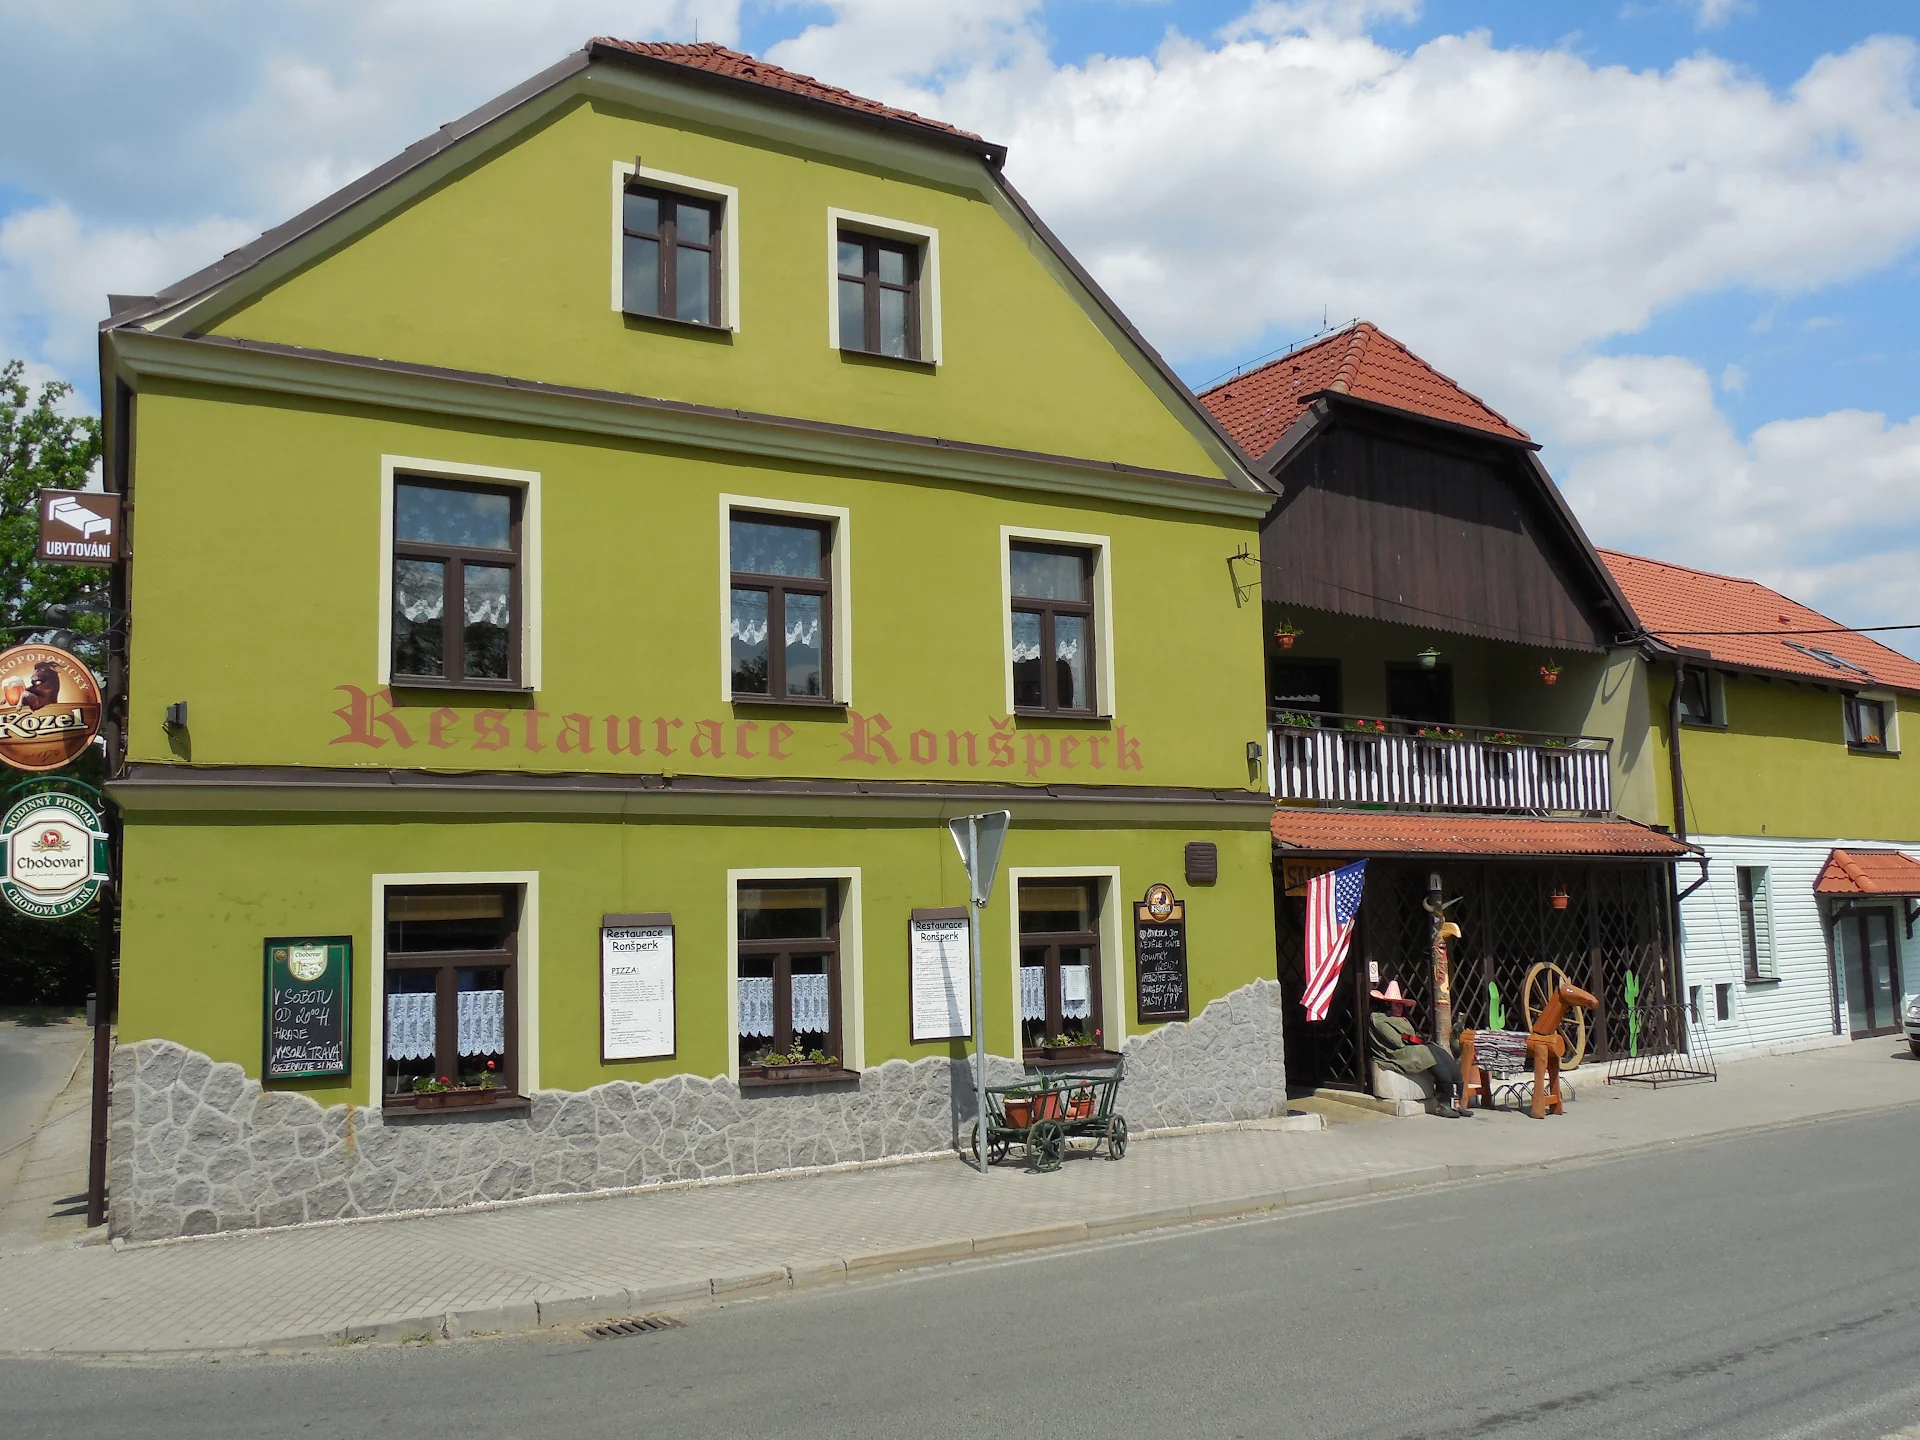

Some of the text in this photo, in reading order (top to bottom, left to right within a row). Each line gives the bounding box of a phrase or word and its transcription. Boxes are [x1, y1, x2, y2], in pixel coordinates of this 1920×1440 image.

[46, 541, 111, 558] UBYTOVÁNÍ
[0, 653, 90, 691] KOPOPOVICKÝ
[0, 708, 87, 738] Kozel
[328, 684, 1145, 778] Restaurace Ronšperk
[7, 796, 95, 828] RODINNÝ PIVOVAR
[17, 856, 84, 869] Chodovar
[8, 888, 57, 915] CHODOVÁ
[915, 921, 963, 929] Restaurace
[606, 929, 663, 938] Restaurace
[920, 931, 959, 943] Ronšperk
[612, 940, 658, 952] Ronšperk
[274, 988, 334, 1005] V SOBOTU
[275, 1007, 291, 1022] OD
[273, 1027, 309, 1040] HRAJE
